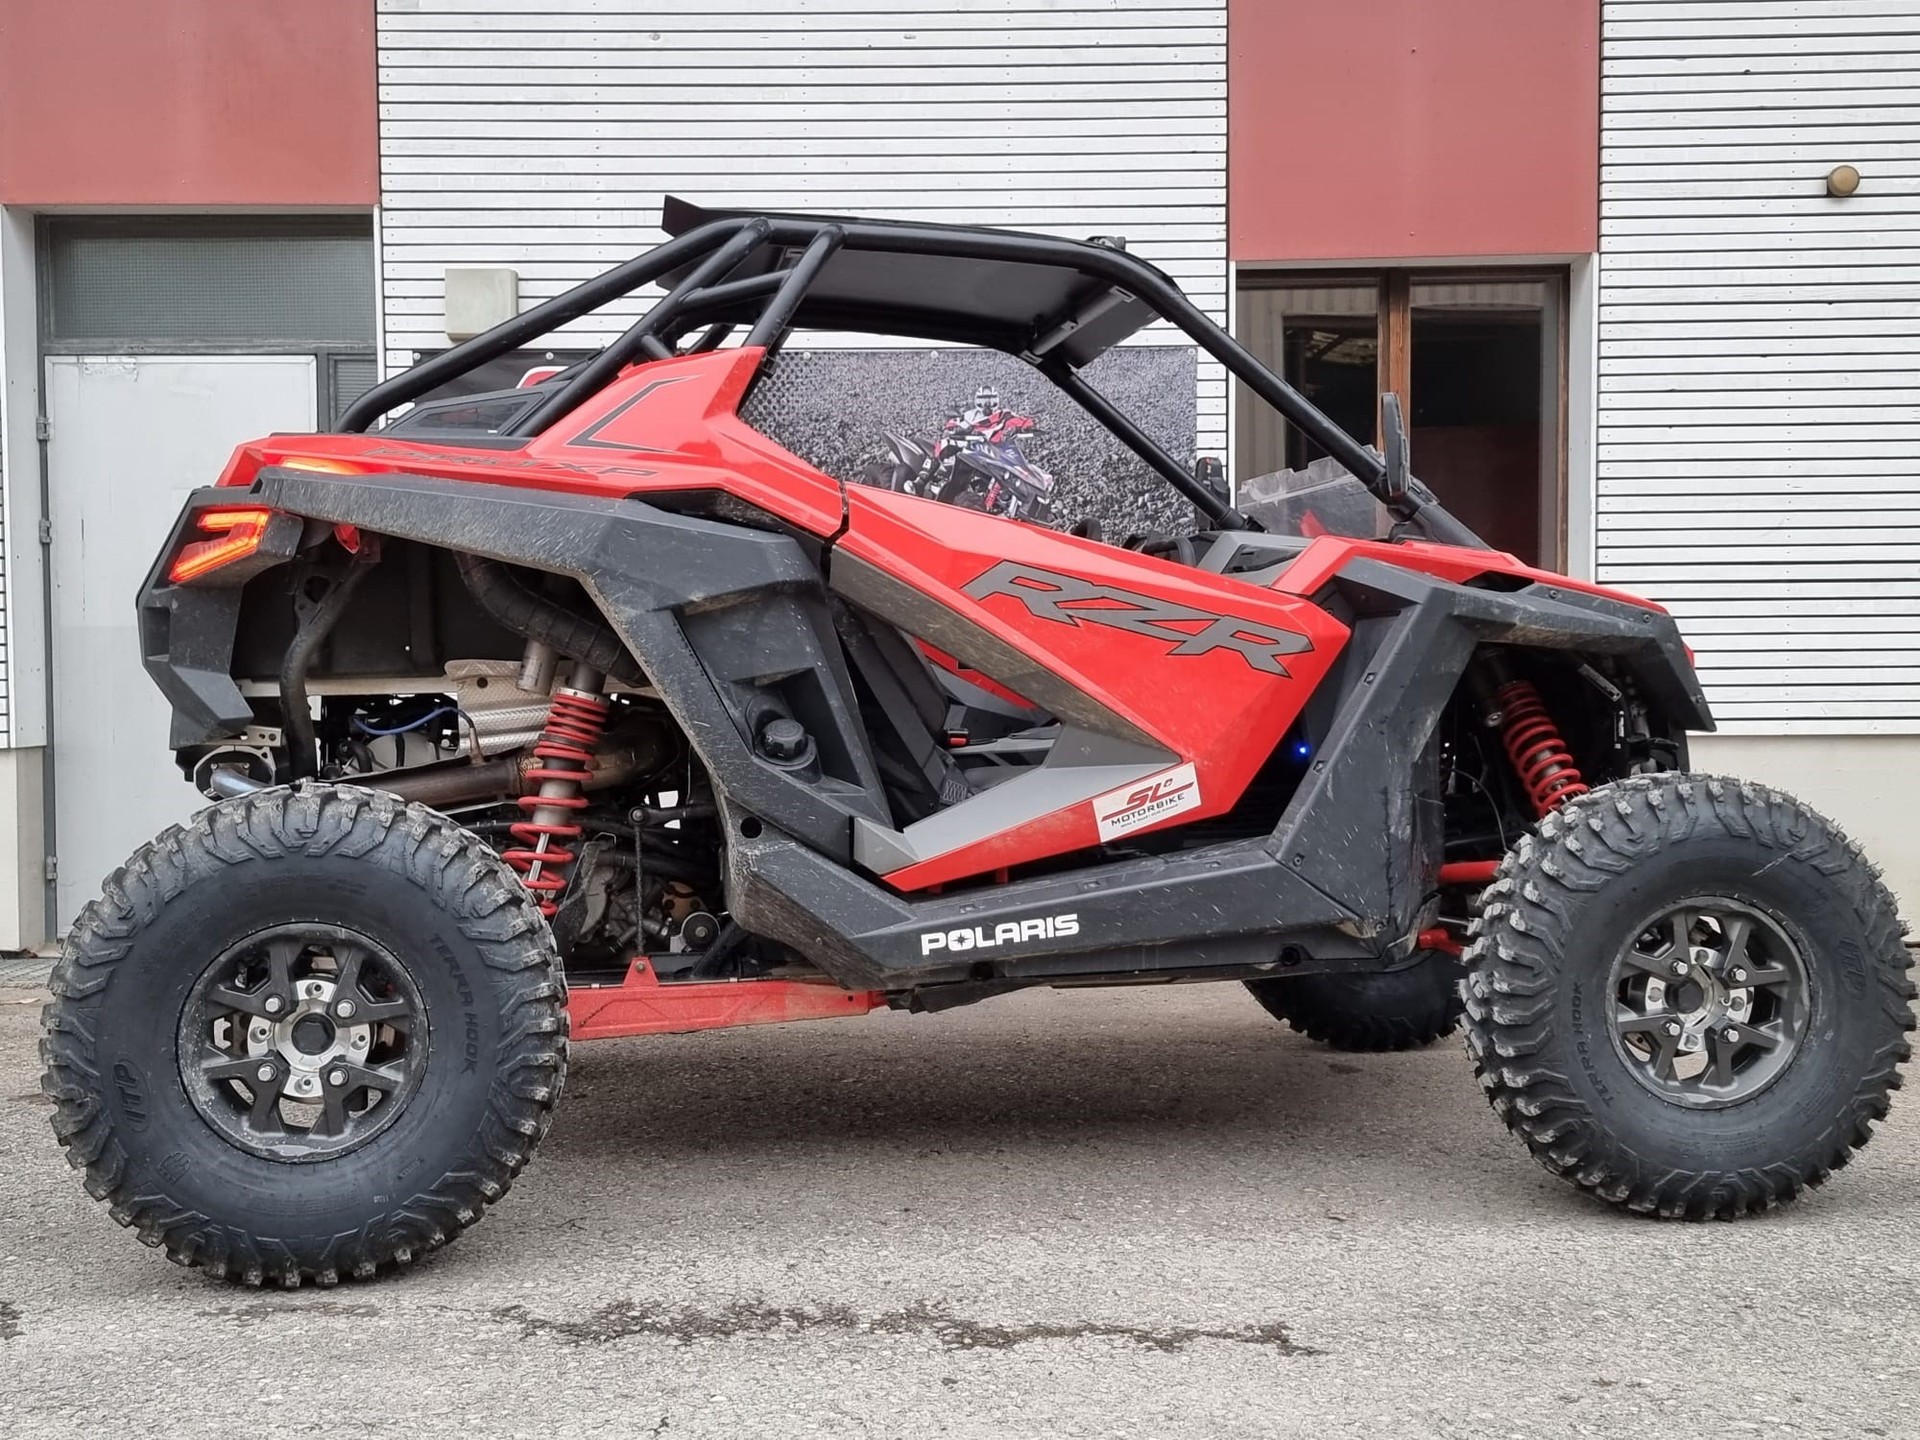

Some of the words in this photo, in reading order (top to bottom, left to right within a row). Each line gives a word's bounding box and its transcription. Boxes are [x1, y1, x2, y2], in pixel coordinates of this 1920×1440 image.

[960, 559, 1315, 679] RZR
[1110, 792, 1185, 827] MOTORBIKE
[920, 913, 1080, 956] POLARIS
[428, 932, 475, 1007] TERRA
[460, 1012, 478, 1075] HOOK
[1571, 981, 1583, 1035] HOOK
[112, 1063, 146, 1121] ITP
